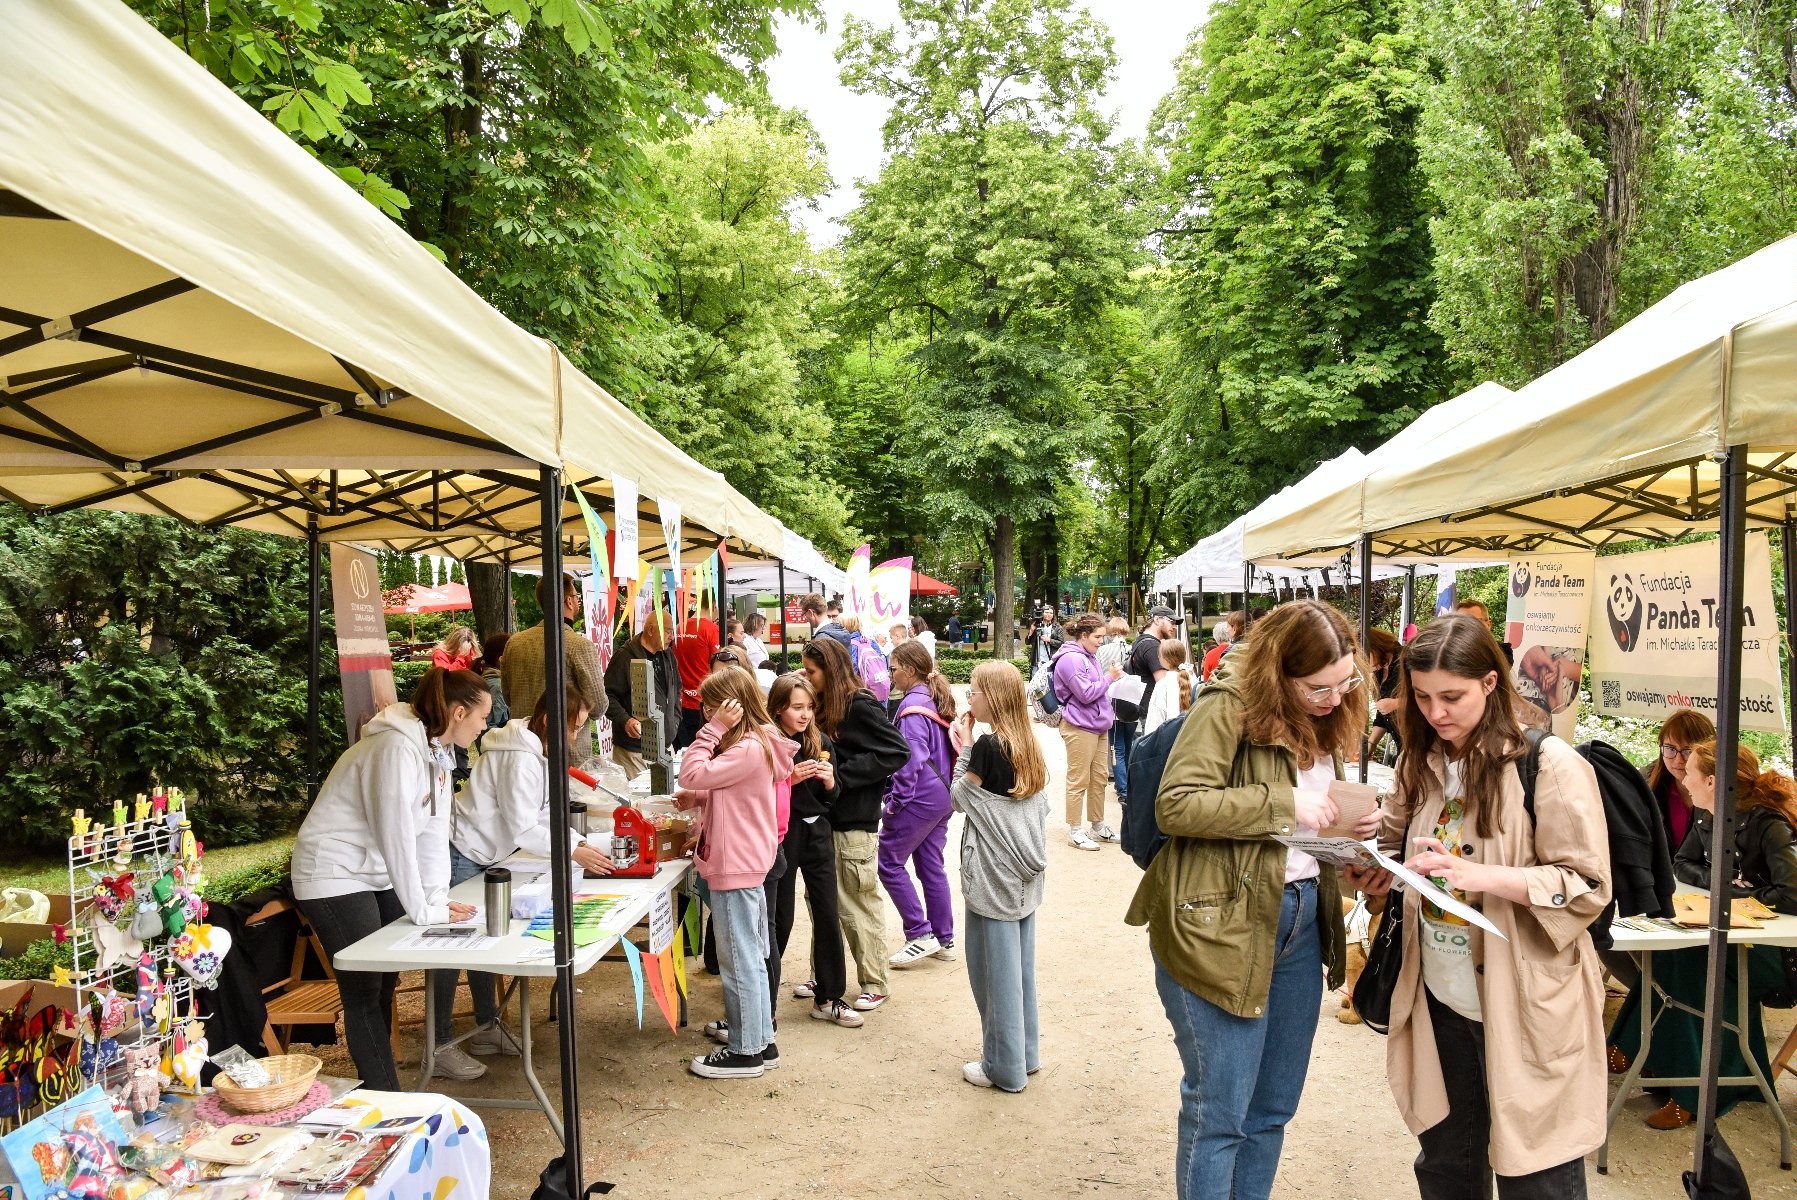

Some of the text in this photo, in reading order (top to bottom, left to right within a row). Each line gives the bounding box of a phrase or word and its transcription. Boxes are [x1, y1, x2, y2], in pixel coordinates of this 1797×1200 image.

[1536, 561, 1562, 572] Fundacja
[1535, 574, 1585, 588] Panda Team
[1640, 570, 1692, 594] Fundacja
[1526, 612, 1556, 622] oswajamy
[1647, 598, 1755, 630] Panda Tem
[1646, 638, 1659, 651] im.
[1626, 688, 1667, 707] oswajamy
[1439, 947, 1472, 955] FLOWERS
